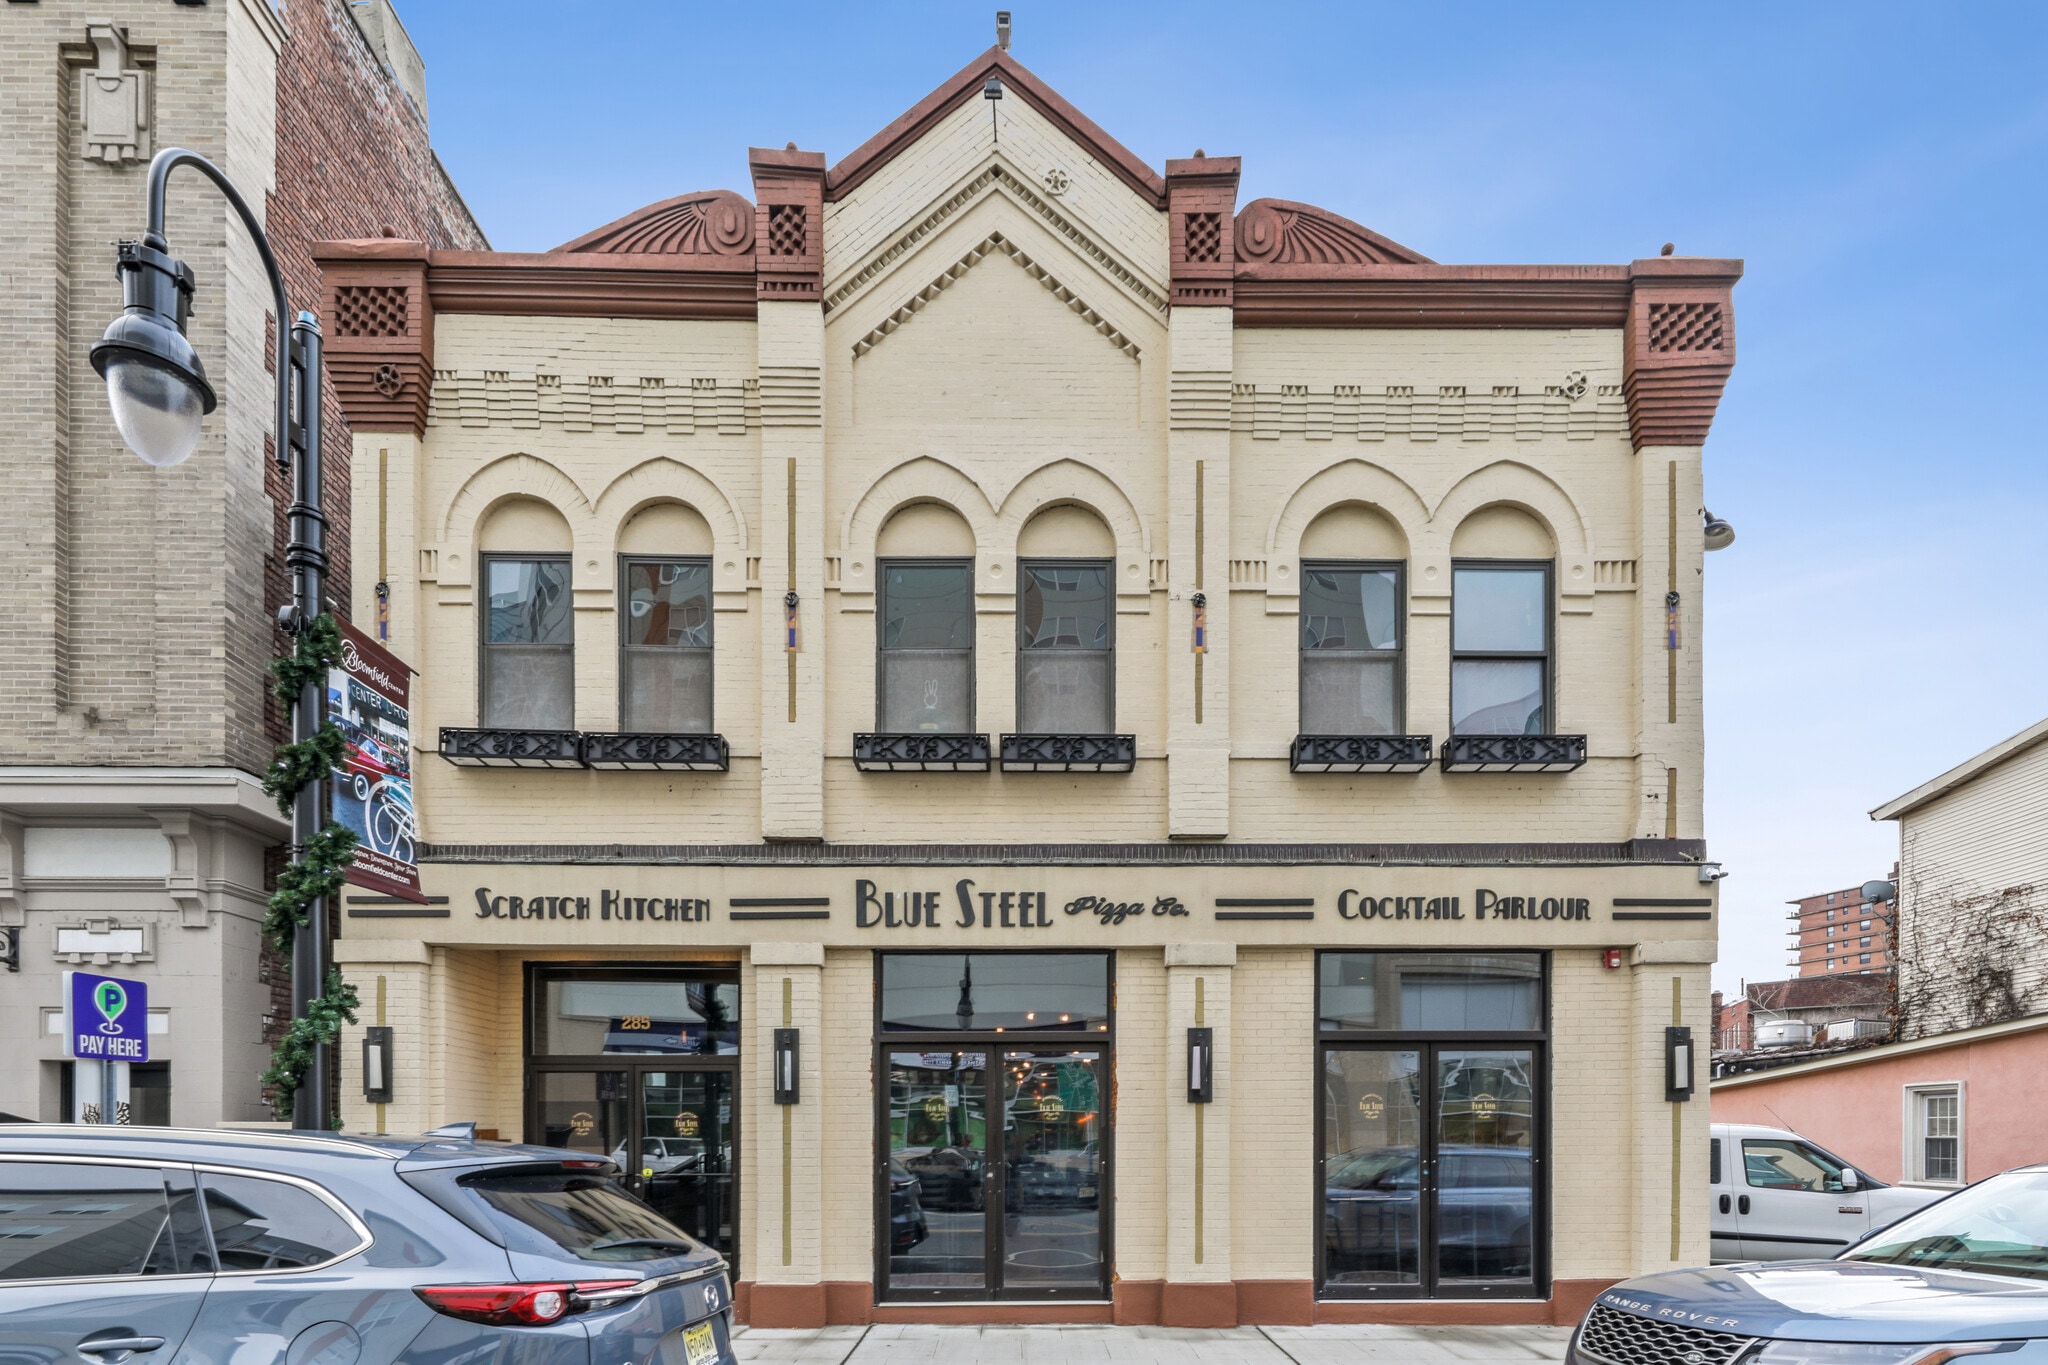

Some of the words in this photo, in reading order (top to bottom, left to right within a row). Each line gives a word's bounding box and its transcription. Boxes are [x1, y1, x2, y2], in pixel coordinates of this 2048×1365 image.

[341, 639, 389, 690] Bloomfield
[388, 682, 405, 696] CENTER
[351, 684, 382, 709] CENTER
[475, 887, 590, 920] SCRATCH
[600, 889, 711, 921] KITCHEN
[855, 879, 942, 928] BLUE
[955, 878, 1053, 928] STEEL
[1063, 896, 1145, 926] Pizza
[1151, 896, 1190, 917] Co.
[1337, 888, 1465, 920] COCKTAIL
[1475, 888, 1591, 921] PARLOUR
[105, 989, 121, 1011] P
[621, 1015, 652, 1030] 285
[80, 1035, 105, 1054] PAY
[108, 1037, 142, 1057] HERE
[1604, 1294, 1652, 1312] RANGE
[1659, 1308, 1739, 1327] ROVER
